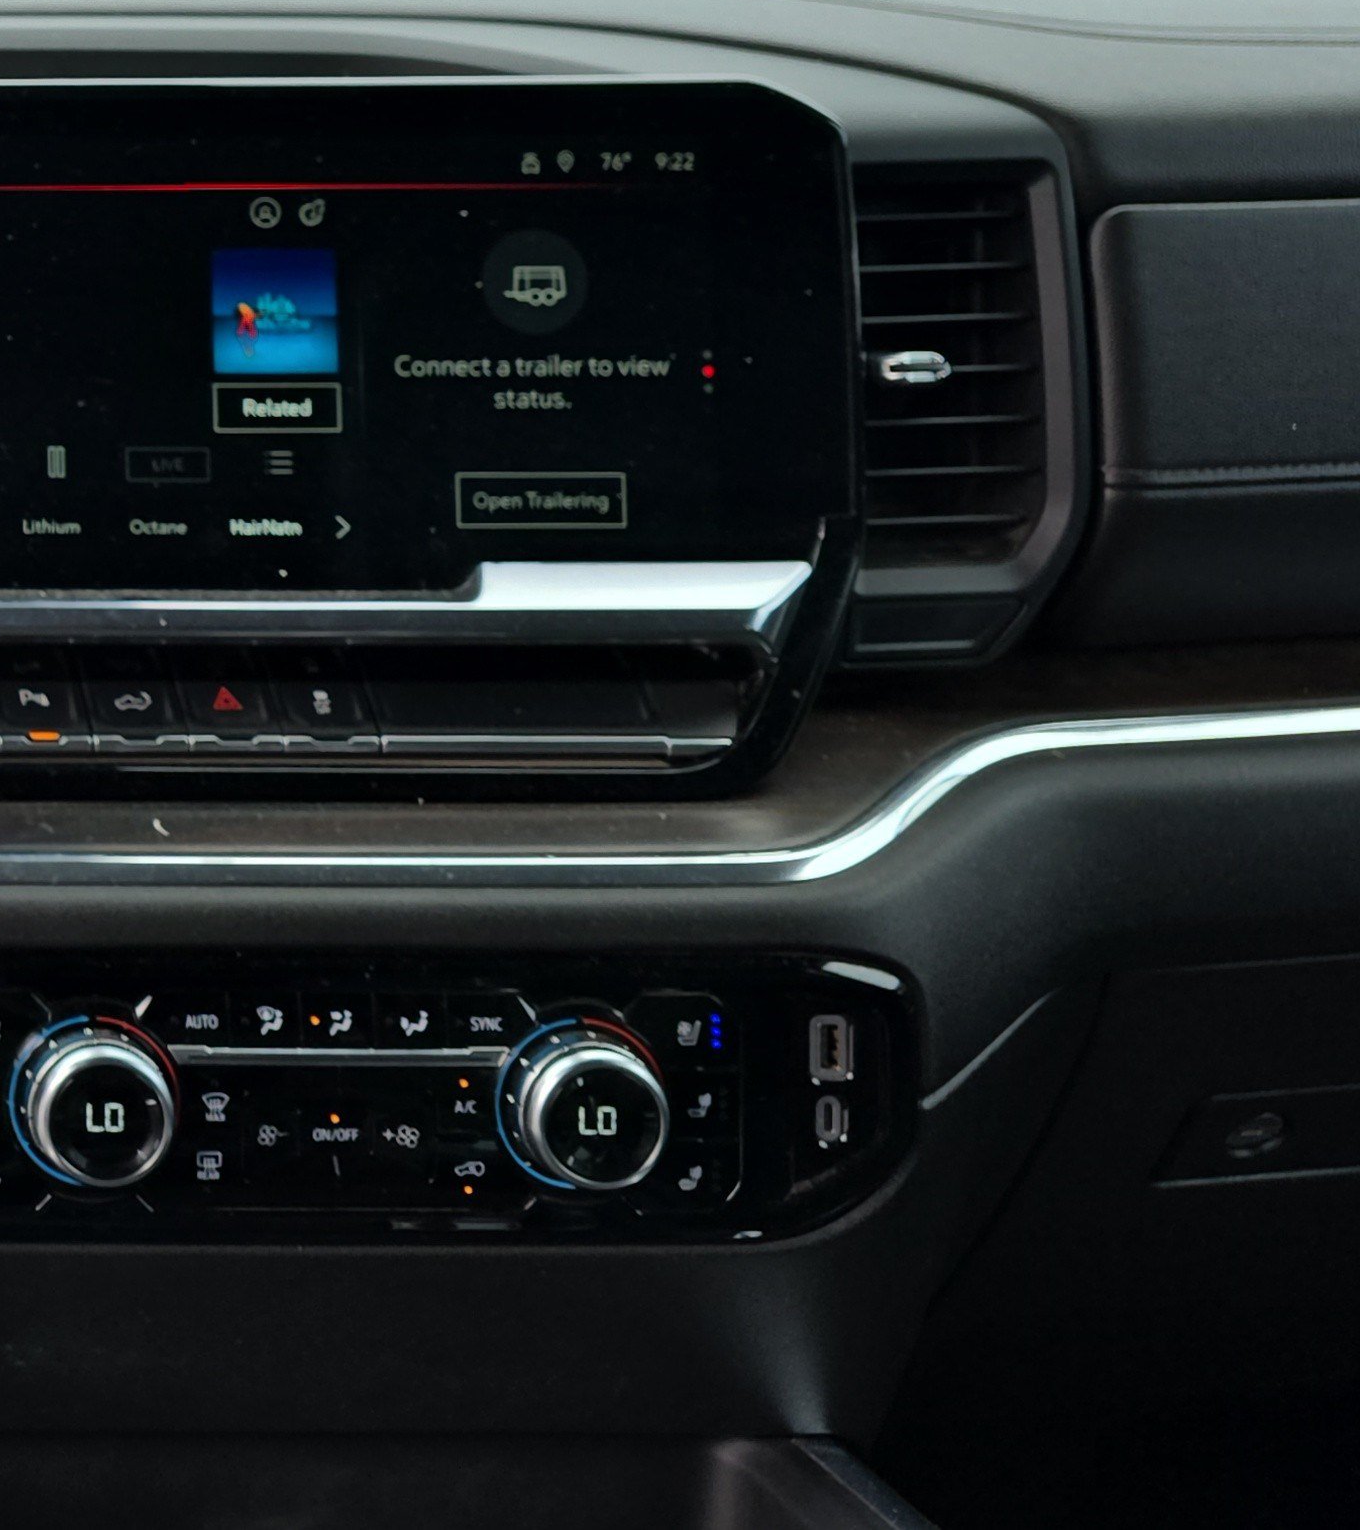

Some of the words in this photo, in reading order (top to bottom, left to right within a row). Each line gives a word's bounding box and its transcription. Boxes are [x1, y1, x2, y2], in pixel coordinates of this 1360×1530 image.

[394, 354, 492, 378] Connect
[496, 359, 511, 377] a
[515, 354, 583, 378] trailer
[588, 357, 614, 378] to
[617, 355, 671, 377] view
[242, 398, 313, 418] Related
[494, 389, 572, 410] status.
[472, 491, 522, 515] Open
[526, 490, 610, 515] Trailering
[22, 518, 81, 535] Lithium
[129, 519, 187, 536] Octane
[185, 1013, 219, 1030] AUTO
[470, 1016, 503, 1032] SYNC
[454, 1099, 477, 1115] A/C
[86, 1102, 125, 1133] LO
[579, 1106, 618, 1136] LO
[313, 1127, 359, 1144] ON/OFF
